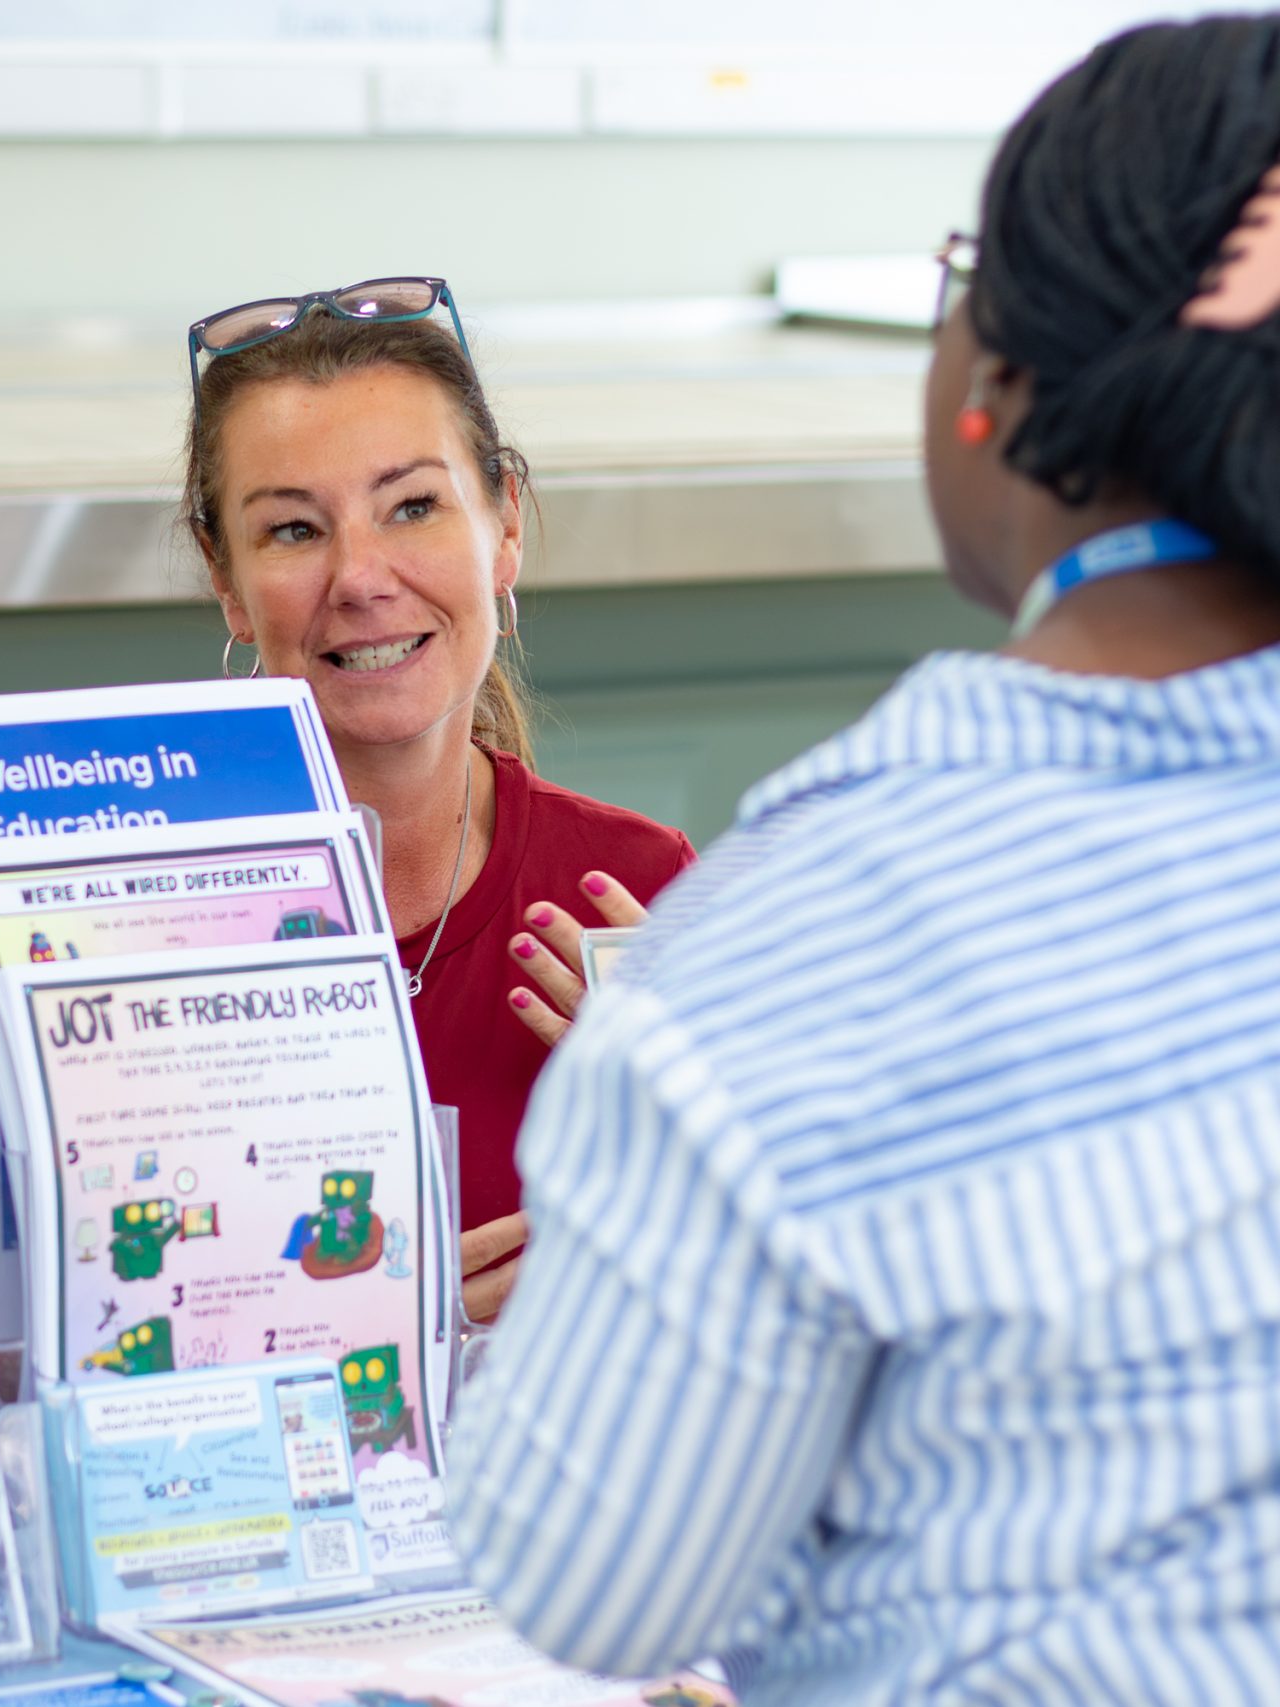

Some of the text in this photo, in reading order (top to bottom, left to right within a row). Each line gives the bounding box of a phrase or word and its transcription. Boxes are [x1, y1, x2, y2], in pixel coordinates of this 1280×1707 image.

[157, 745, 197, 779] in
[22, 864, 309, 905] WE'RE ALL WIRED DIFFERENTLY.
[50, 978, 380, 1049] JOT THE FRIENDLY ROBOT
[66, 1141, 80, 1166] 5
[245, 1142, 258, 1167] 4
[172, 1284, 185, 1308] 3
[264, 1328, 277, 1354] 2
[250, 1454, 272, 1465] and
[181, 1546, 220, 1561] people
